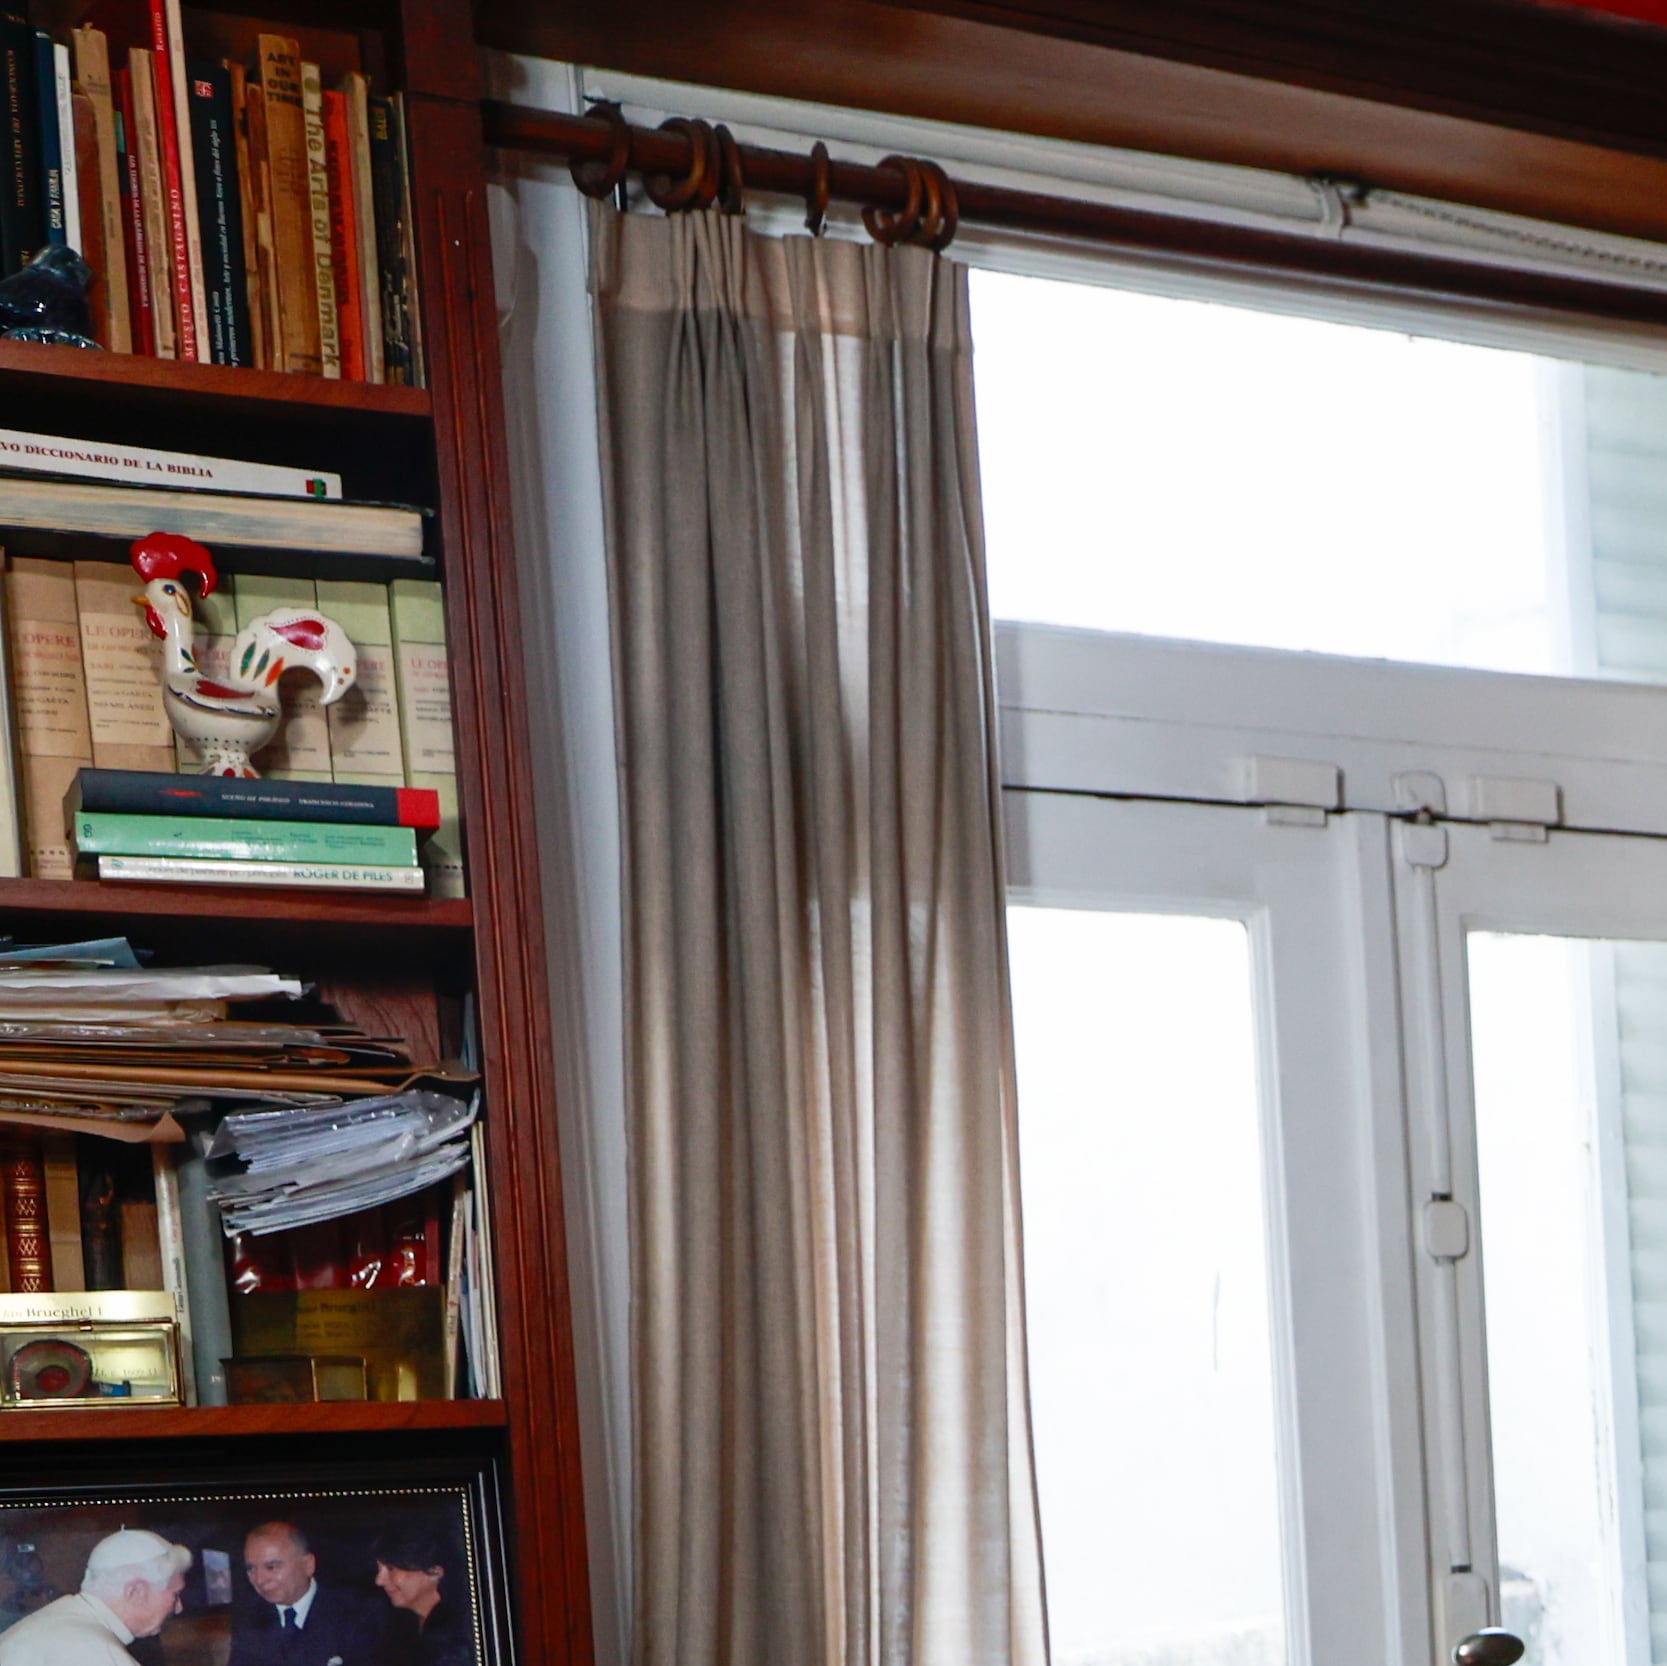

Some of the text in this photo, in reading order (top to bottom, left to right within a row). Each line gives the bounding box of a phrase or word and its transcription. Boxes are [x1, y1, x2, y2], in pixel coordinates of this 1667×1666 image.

[305, 105, 326, 156] The
[309, 160, 330, 211] Arts
[170, 188, 190, 293] CASTAGNINO
[312, 217, 333, 244] of
[24, 444, 120, 467] DICCIONARIO
[123, 457, 144, 470] DE
[146, 460, 164, 472] LA
[167, 463, 215, 479] BIBLIA
[293, 867, 340, 880] ROGER
[344, 870, 361, 881] DE
[362, 871, 393, 883] PILES
[26, 1306, 92, 1319] Brueghel
